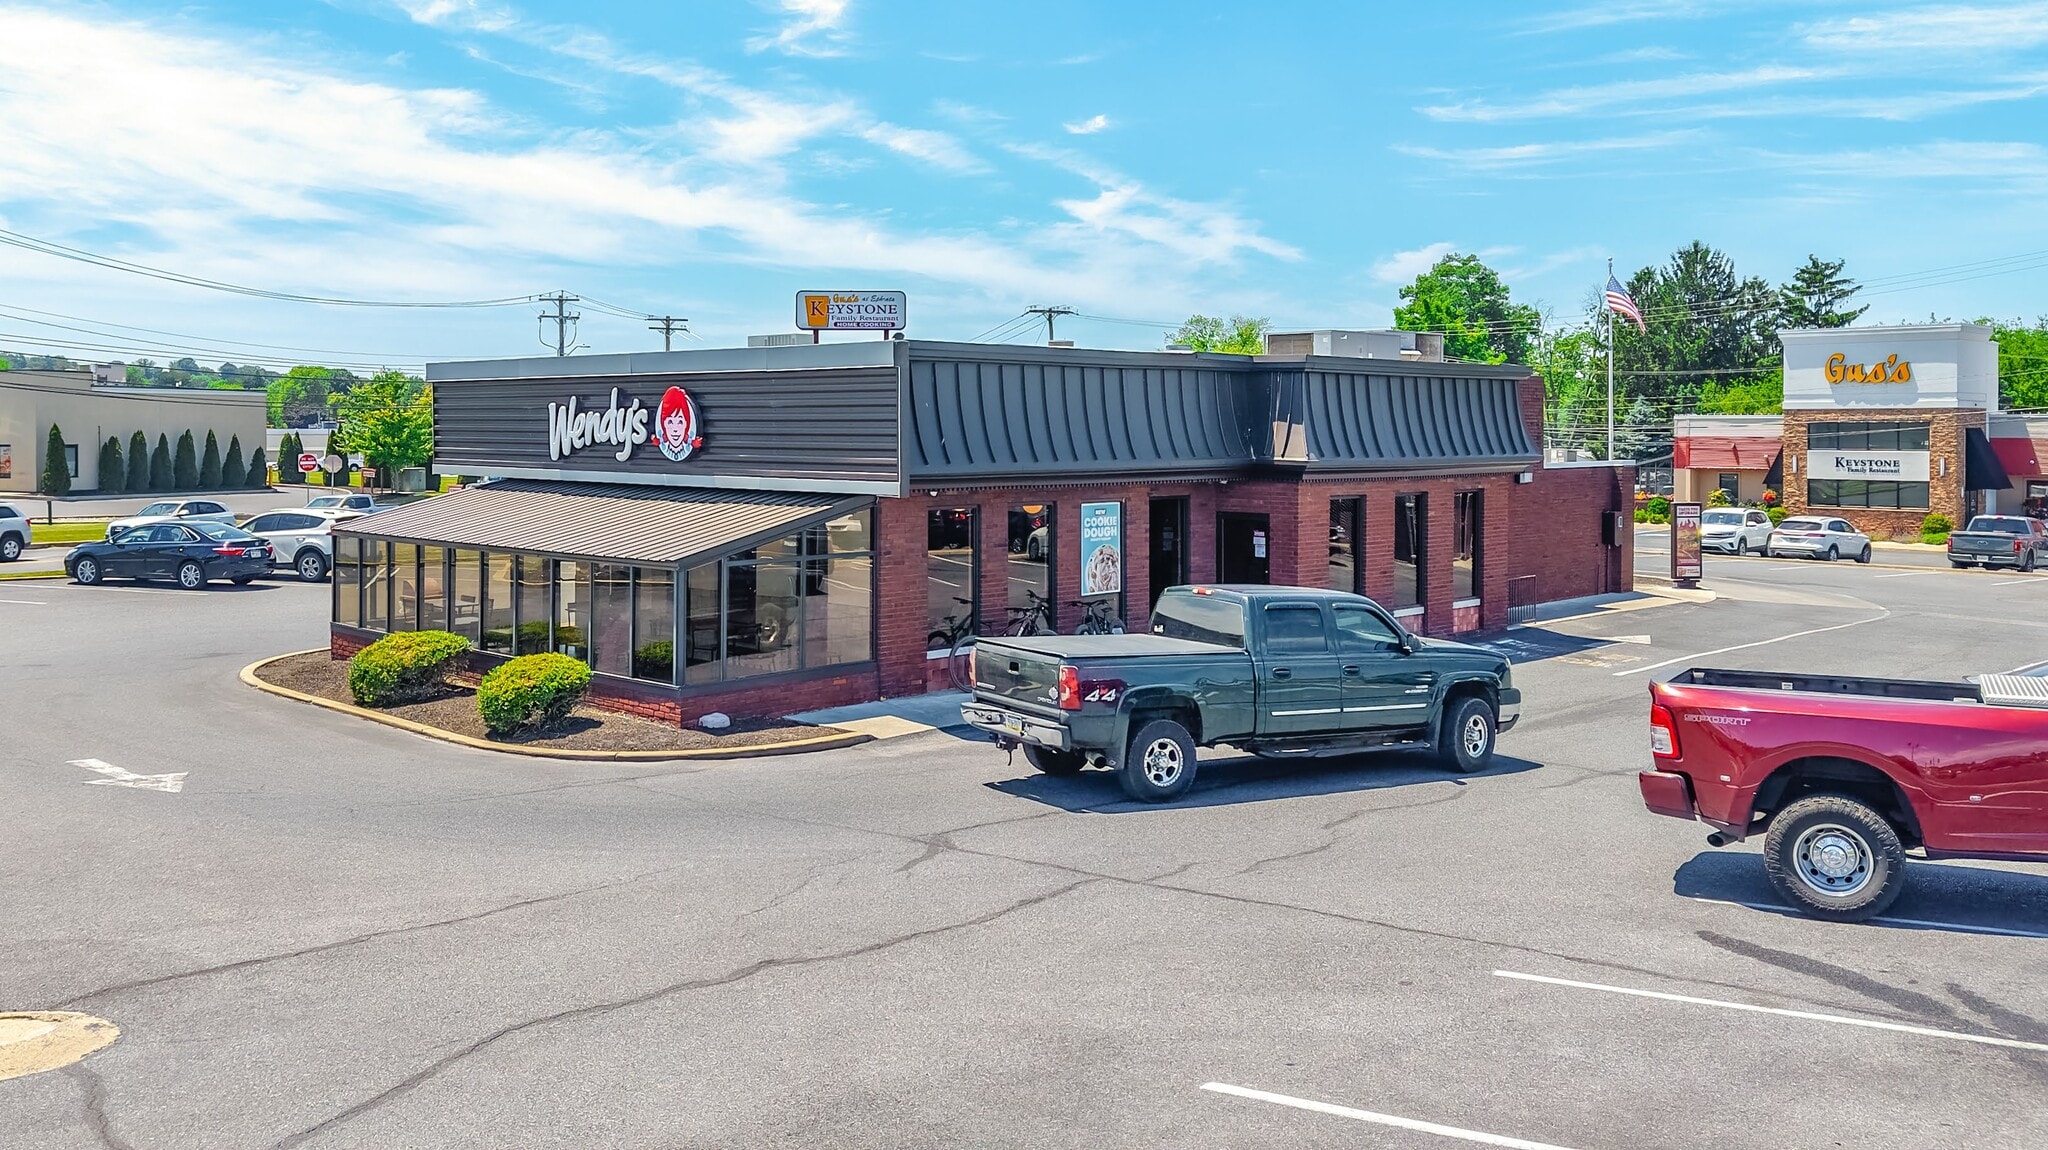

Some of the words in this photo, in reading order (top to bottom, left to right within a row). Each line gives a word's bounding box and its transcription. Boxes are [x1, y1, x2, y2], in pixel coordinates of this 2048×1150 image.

[811, 301, 898, 316] KEYSTONE
[1824, 352, 1912, 385] Gus's
[548, 386, 649, 462] Wendy's
[1835, 456, 1900, 468] KEYSTONE
[1847, 466, 1867, 474] Family
[1084, 516, 1118, 527] COOKIE
[1084, 526, 1117, 538] DOUGH
[1684, 713, 1752, 726] SPORT
